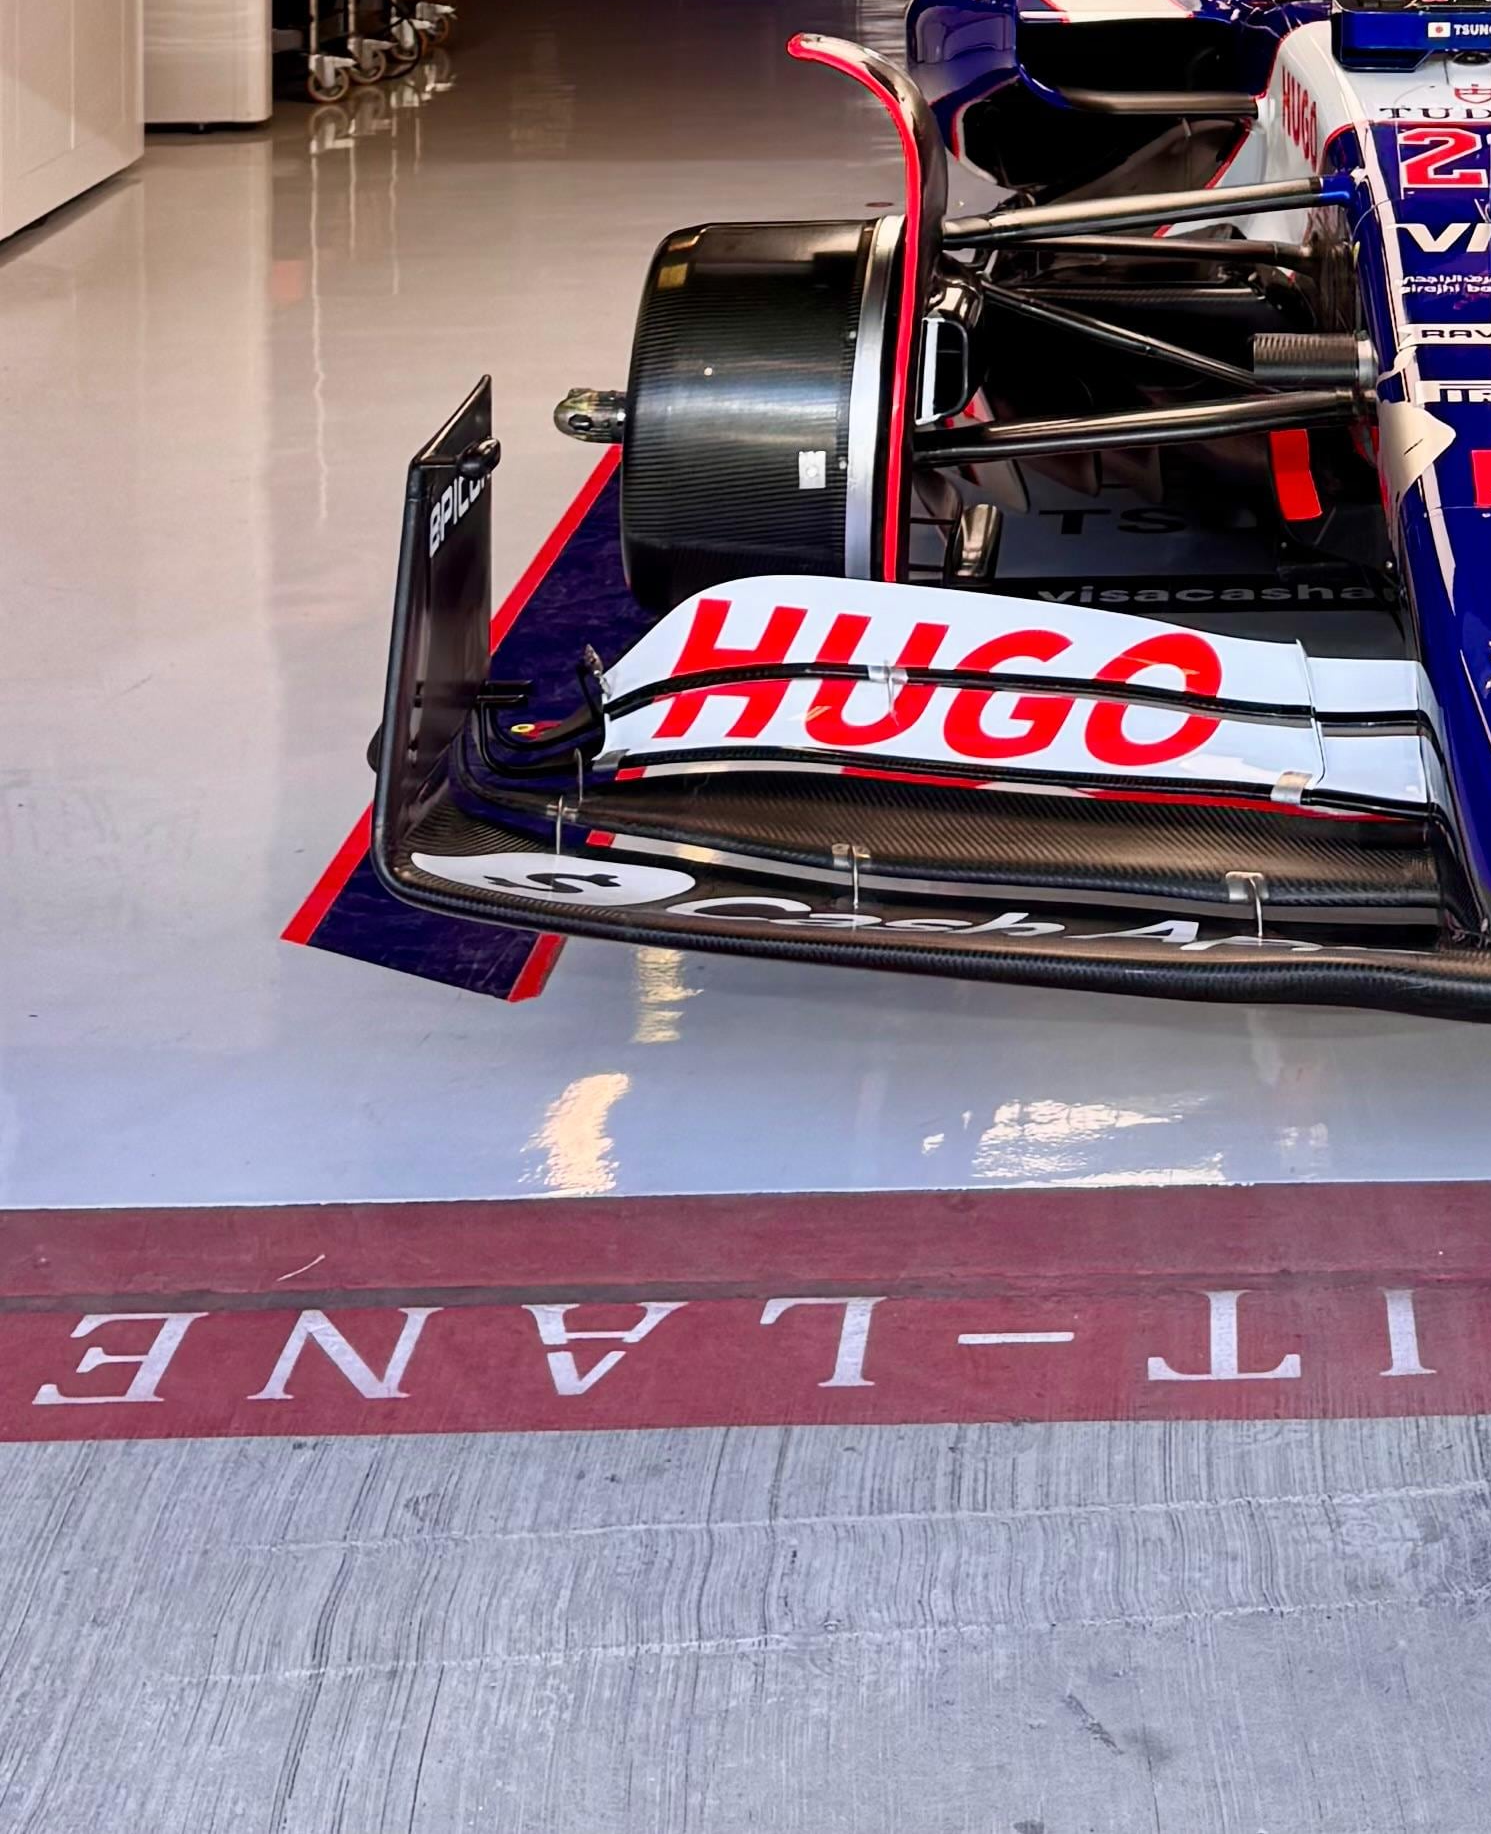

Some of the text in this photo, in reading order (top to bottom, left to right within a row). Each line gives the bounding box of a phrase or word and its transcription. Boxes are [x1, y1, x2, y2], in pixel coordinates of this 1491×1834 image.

[1282, 65, 1317, 174] HUGO
[654, 597, 1223, 766] HUGO
[667, 896, 1067, 936] Cash
